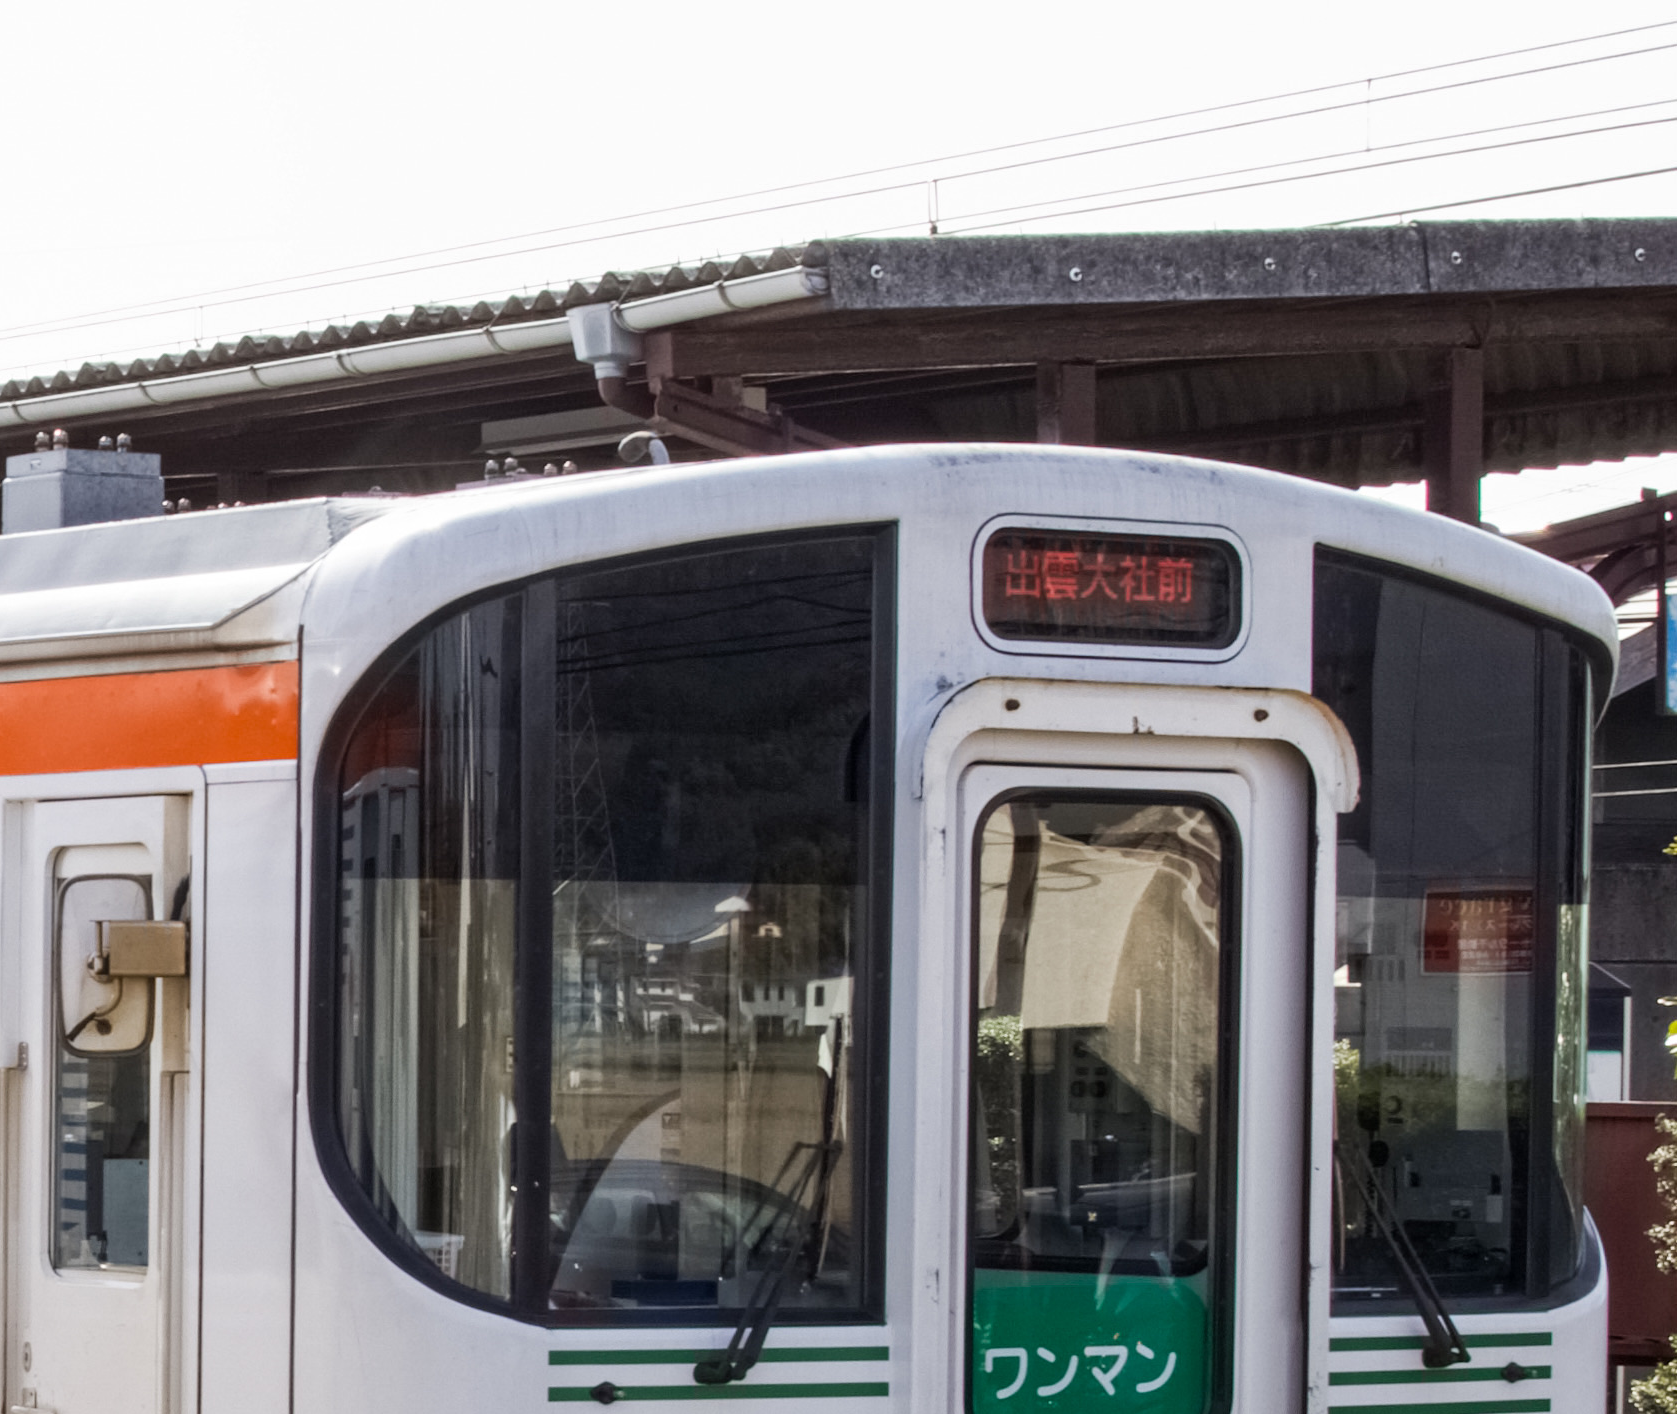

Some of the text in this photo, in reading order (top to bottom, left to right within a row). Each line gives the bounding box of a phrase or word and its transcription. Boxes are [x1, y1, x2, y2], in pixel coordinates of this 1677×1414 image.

[1005, 550, 1194, 604] 出雲大社前
[985, 1344, 1177, 1399] ワンマン
